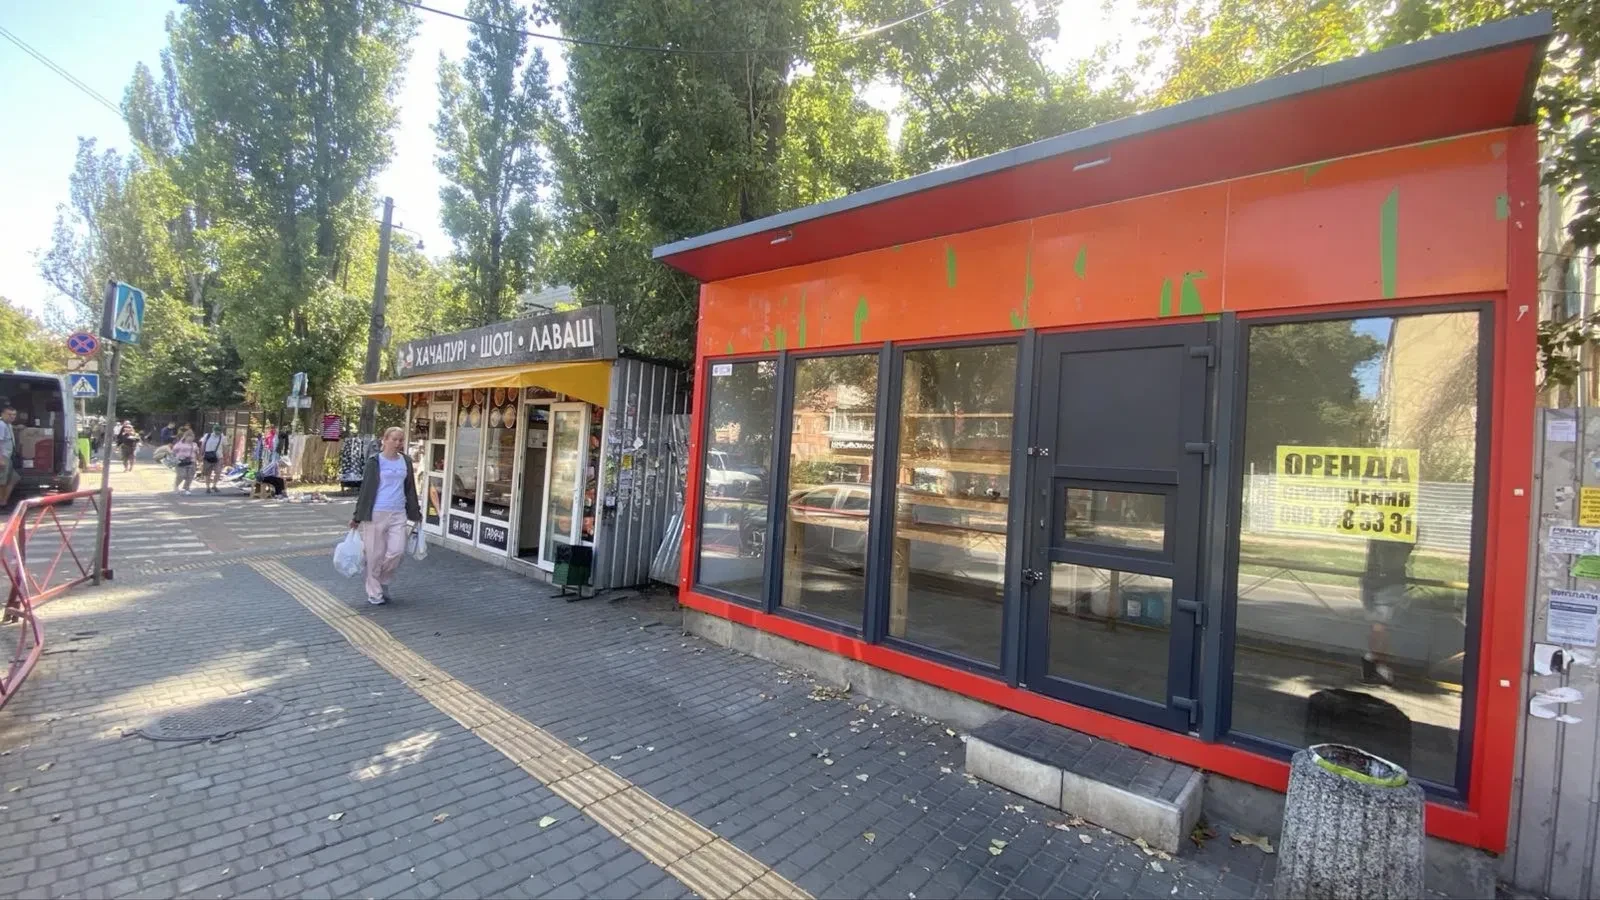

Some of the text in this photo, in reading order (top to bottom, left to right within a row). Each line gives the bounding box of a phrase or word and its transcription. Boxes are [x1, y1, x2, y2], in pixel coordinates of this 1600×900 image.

[416, 318, 595, 366] ХАЧАПУРІ ШОТІ ЛАВАШ
[1284, 453, 1410, 484] ОРЕНДА
[1360, 511, 1385, 533] 33
[1390, 512, 1412, 535] 31
[1552, 527, 1598, 536] РЕМОНТ
[1551, 590, 1599, 600] ВИПЛАТИ
